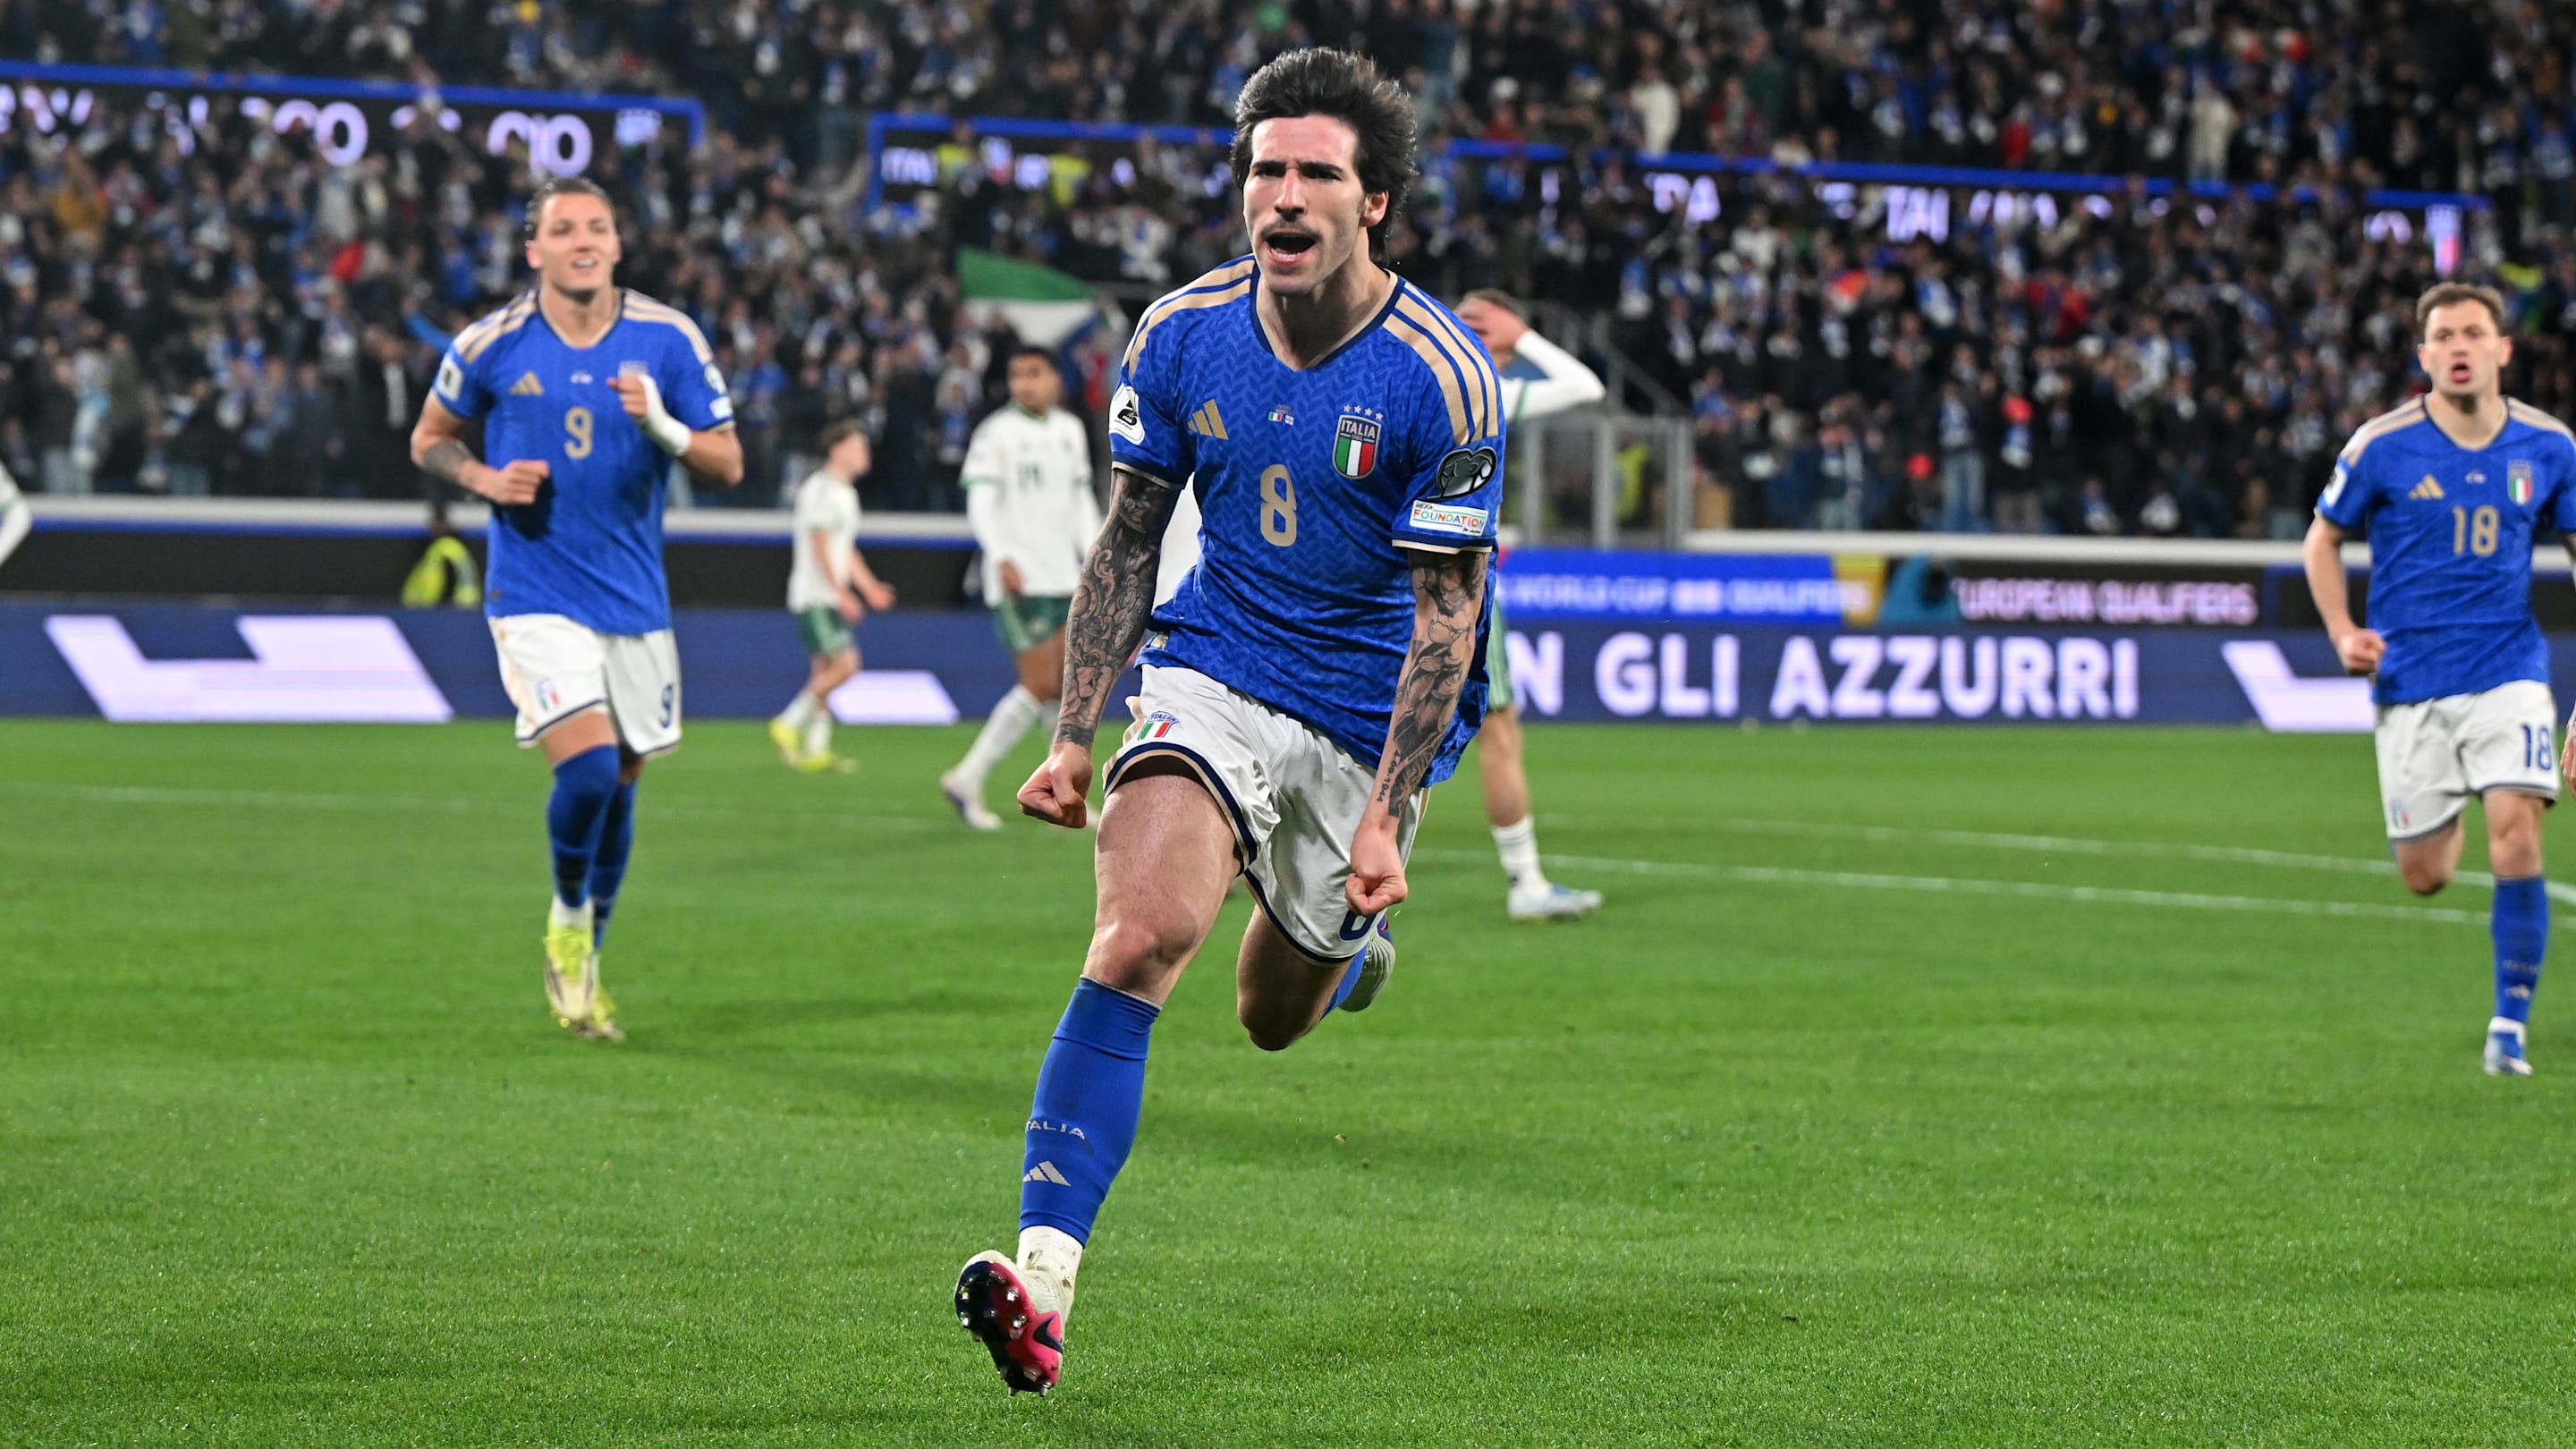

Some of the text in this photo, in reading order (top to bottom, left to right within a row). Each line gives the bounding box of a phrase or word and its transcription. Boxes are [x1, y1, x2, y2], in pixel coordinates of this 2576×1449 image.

[564, 406, 594, 460] 9
[1341, 419, 1376, 439] ITALIA
[1259, 463, 1297, 547] 8
[1413, 507, 1485, 530] FOUNDATION
[2452, 504, 2500, 558] 18
[1595, 631, 1741, 716] GLI
[1768, 634, 2140, 718] AZZURRI
[658, 683, 674, 729] 9
[1150, 713, 1177, 723] ITALIA
[2521, 723, 2553, 772] 18
[1026, 1120, 1085, 1140] TALIA
